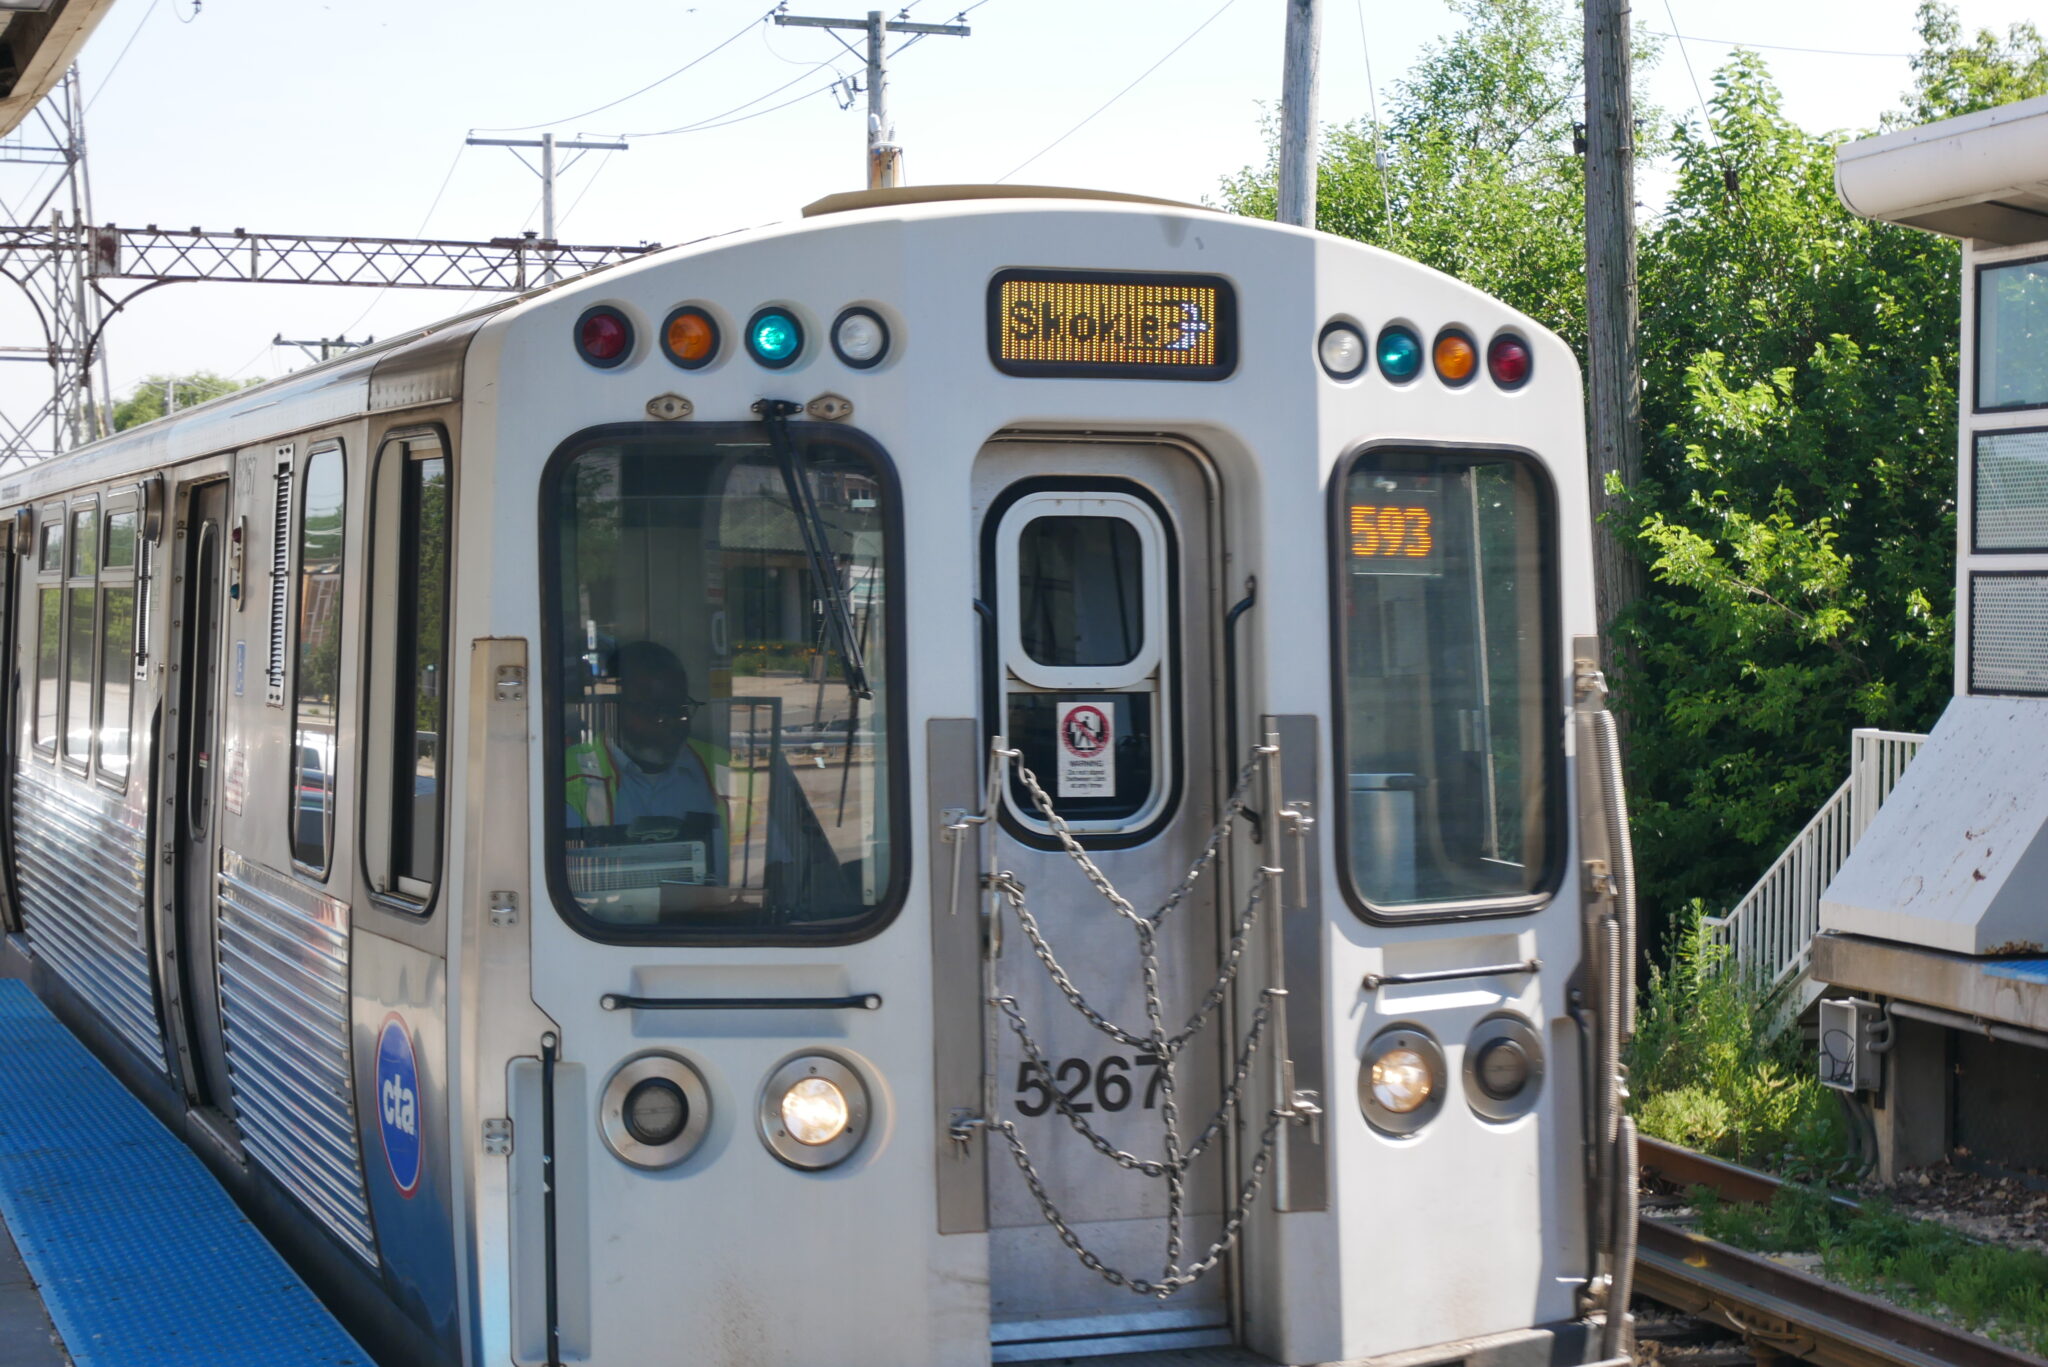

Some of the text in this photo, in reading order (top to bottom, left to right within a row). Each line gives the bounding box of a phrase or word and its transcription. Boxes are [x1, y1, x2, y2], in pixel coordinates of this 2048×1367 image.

[1011, 300, 1160, 344] Skokie
[1351, 507, 1431, 556] 593
[383, 1073, 415, 1136] cta
[1014, 1055, 1164, 1117] 5267
